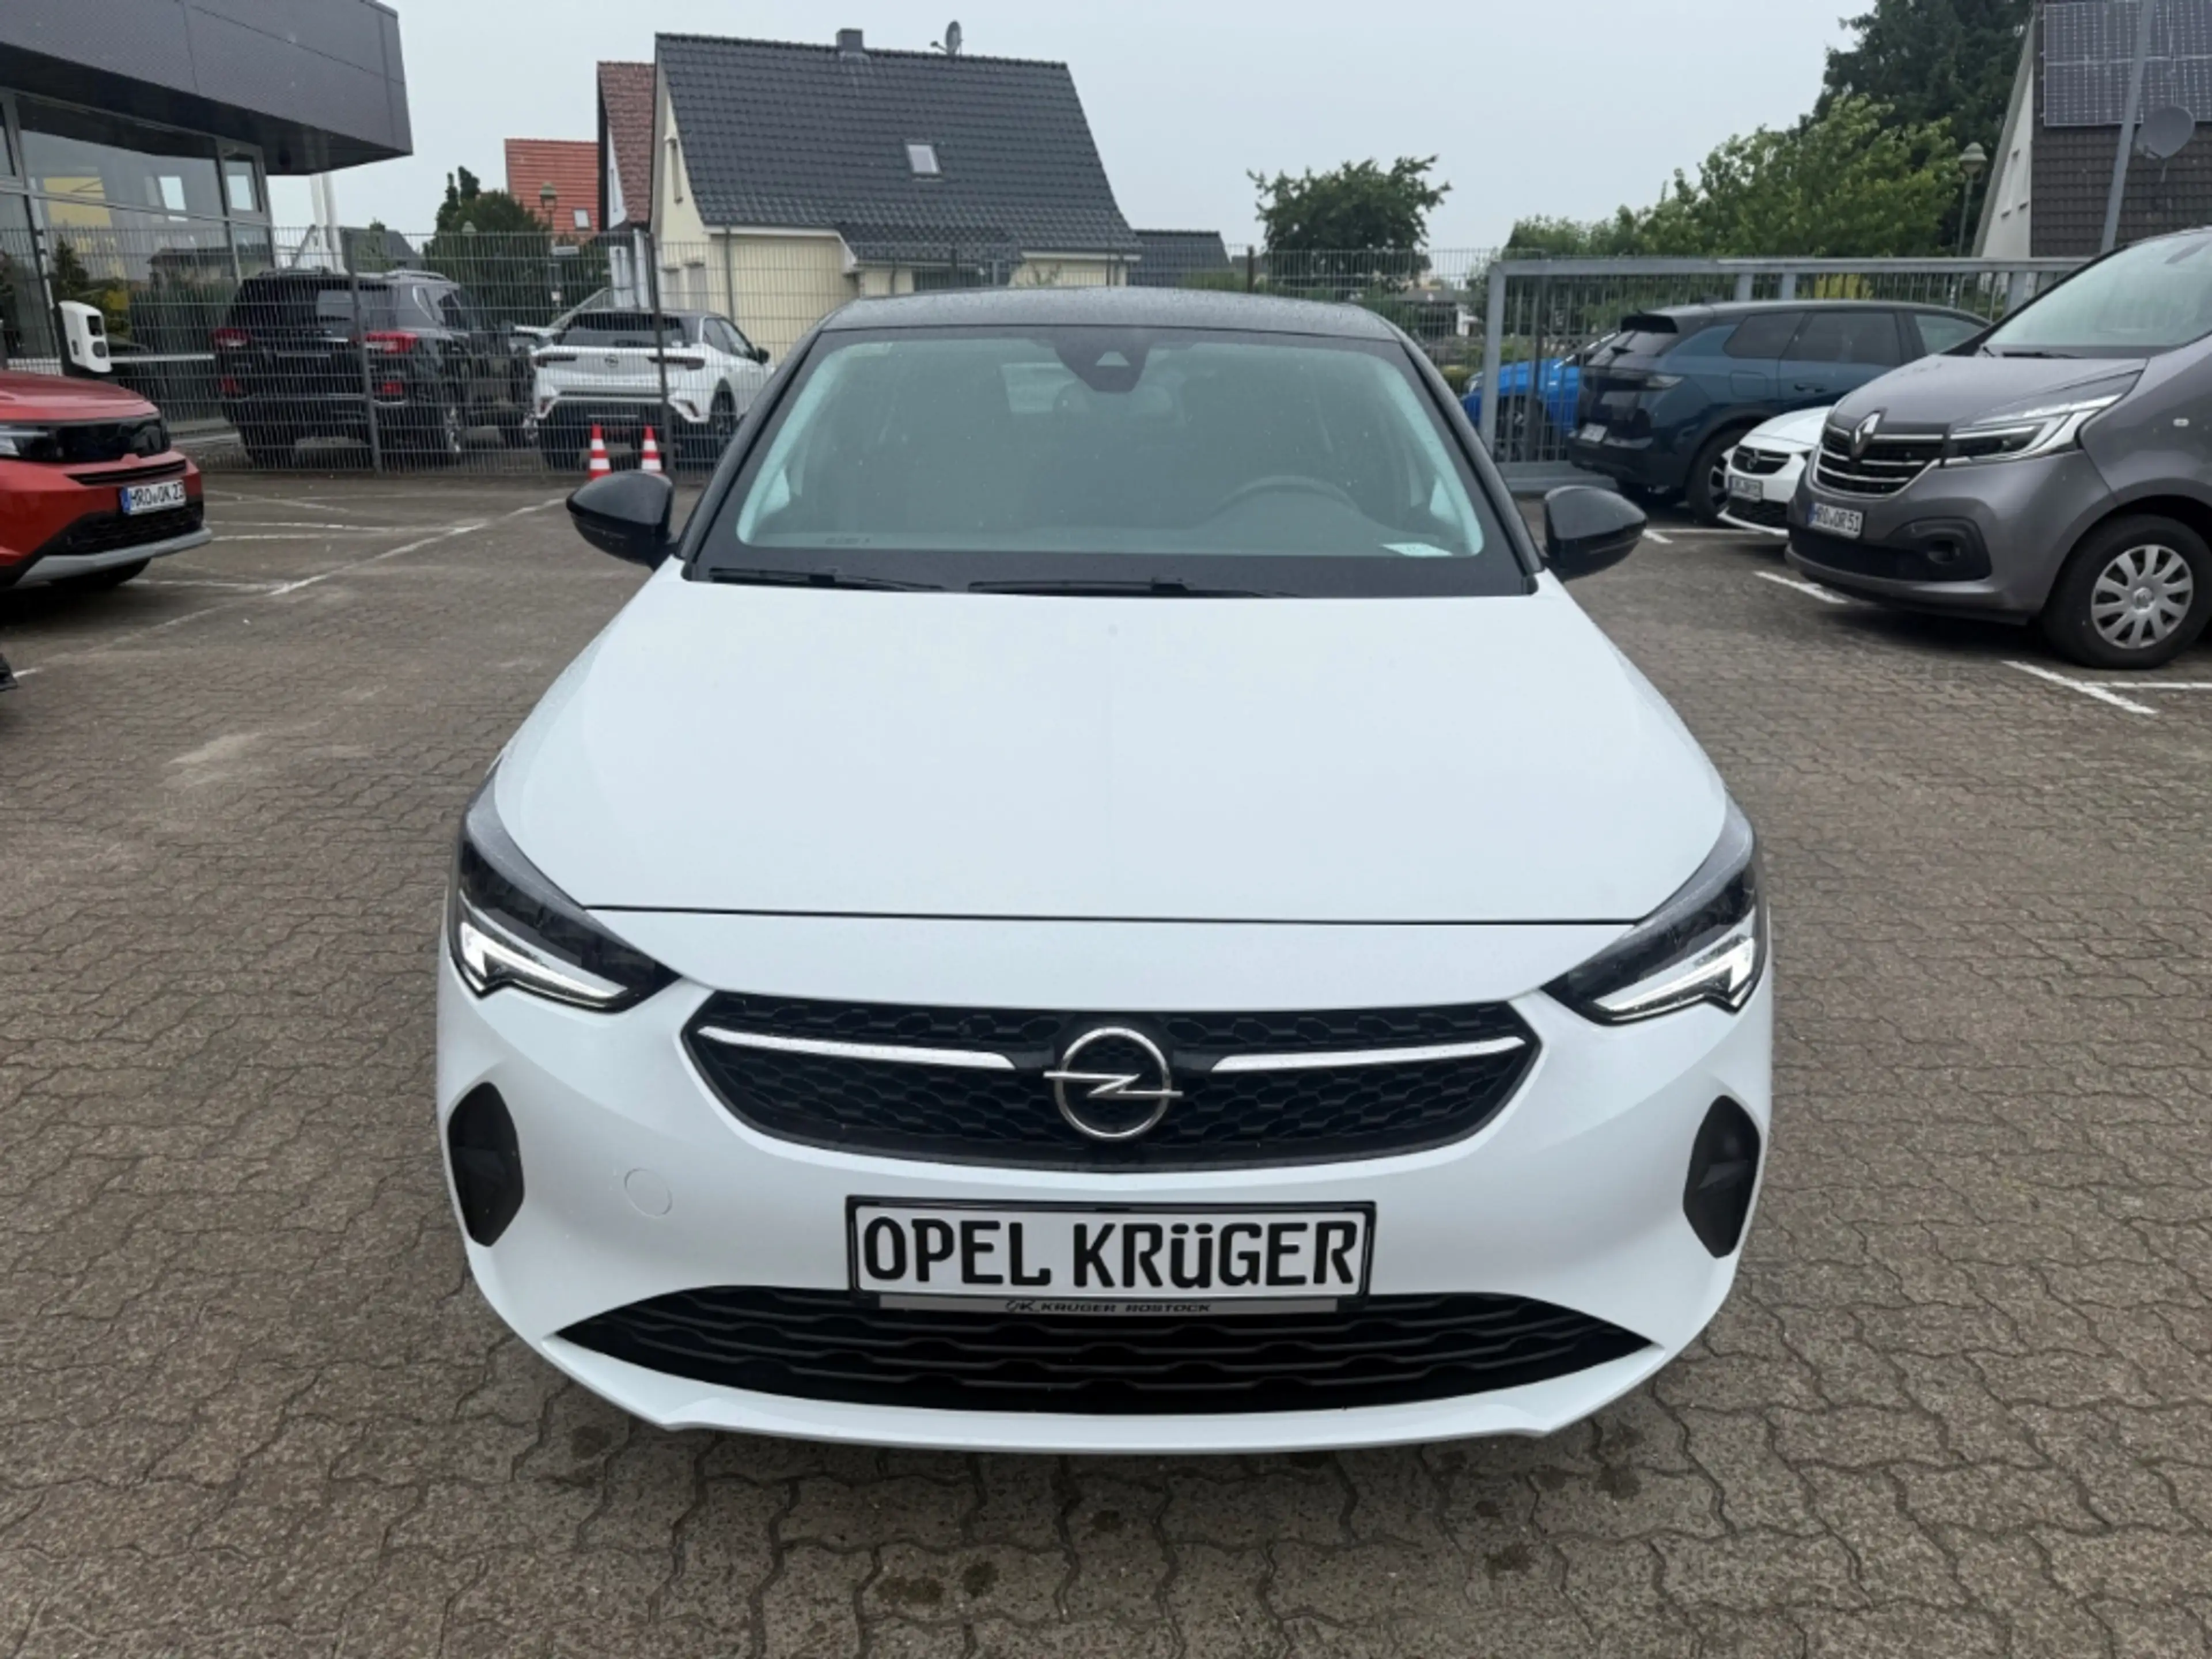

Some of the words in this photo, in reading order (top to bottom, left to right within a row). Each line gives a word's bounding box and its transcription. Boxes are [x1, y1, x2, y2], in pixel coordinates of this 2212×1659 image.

[1847, 513, 1859, 532] 51
[864, 1216, 1051, 1286] OPEL
[1125, 1304, 1211, 1312] ROSTOCK
